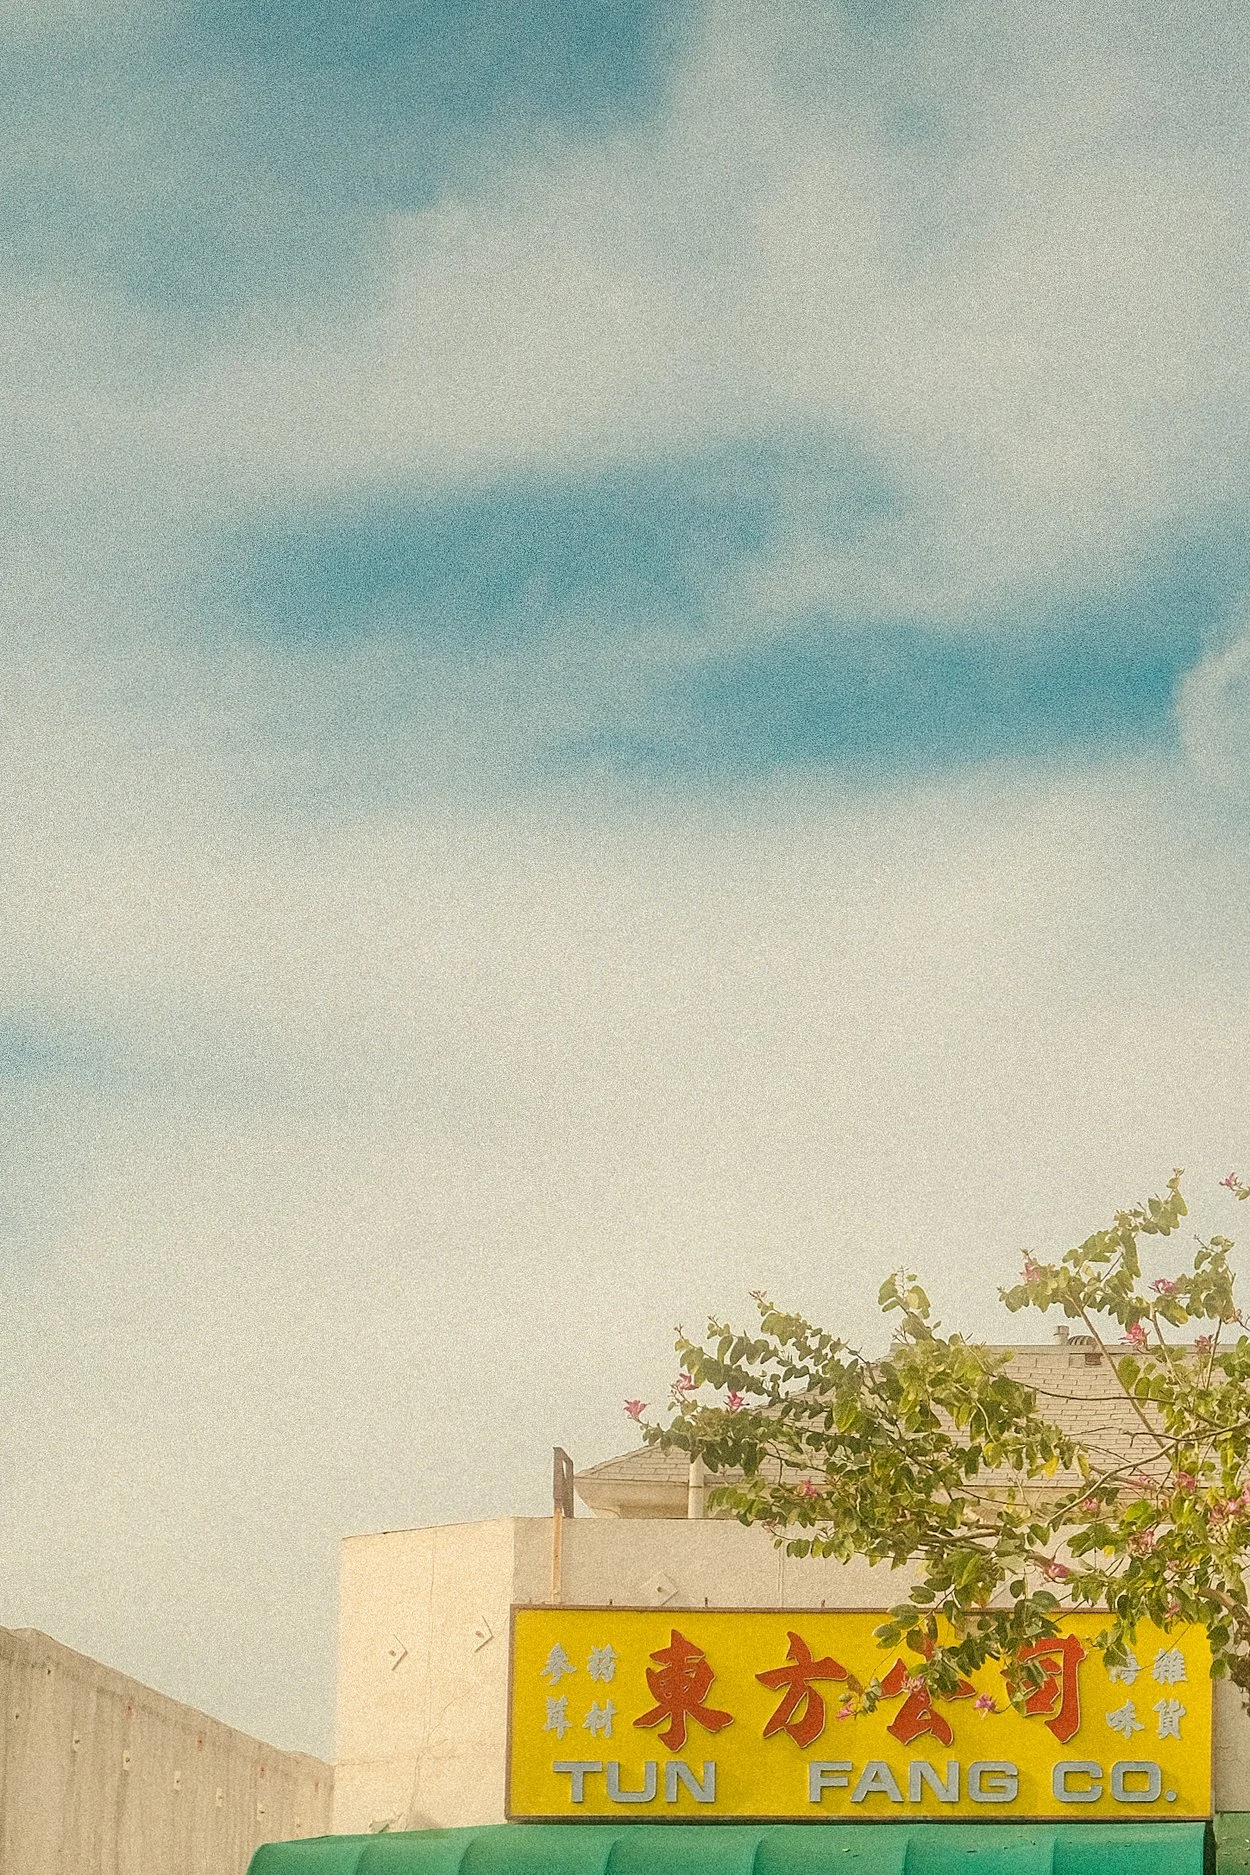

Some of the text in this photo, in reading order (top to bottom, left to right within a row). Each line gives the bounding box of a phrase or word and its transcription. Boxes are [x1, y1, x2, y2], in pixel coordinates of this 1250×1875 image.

[632, 1628, 1087, 1754] 東方公司
[551, 1760, 1178, 1804] TUN FANG CO.
